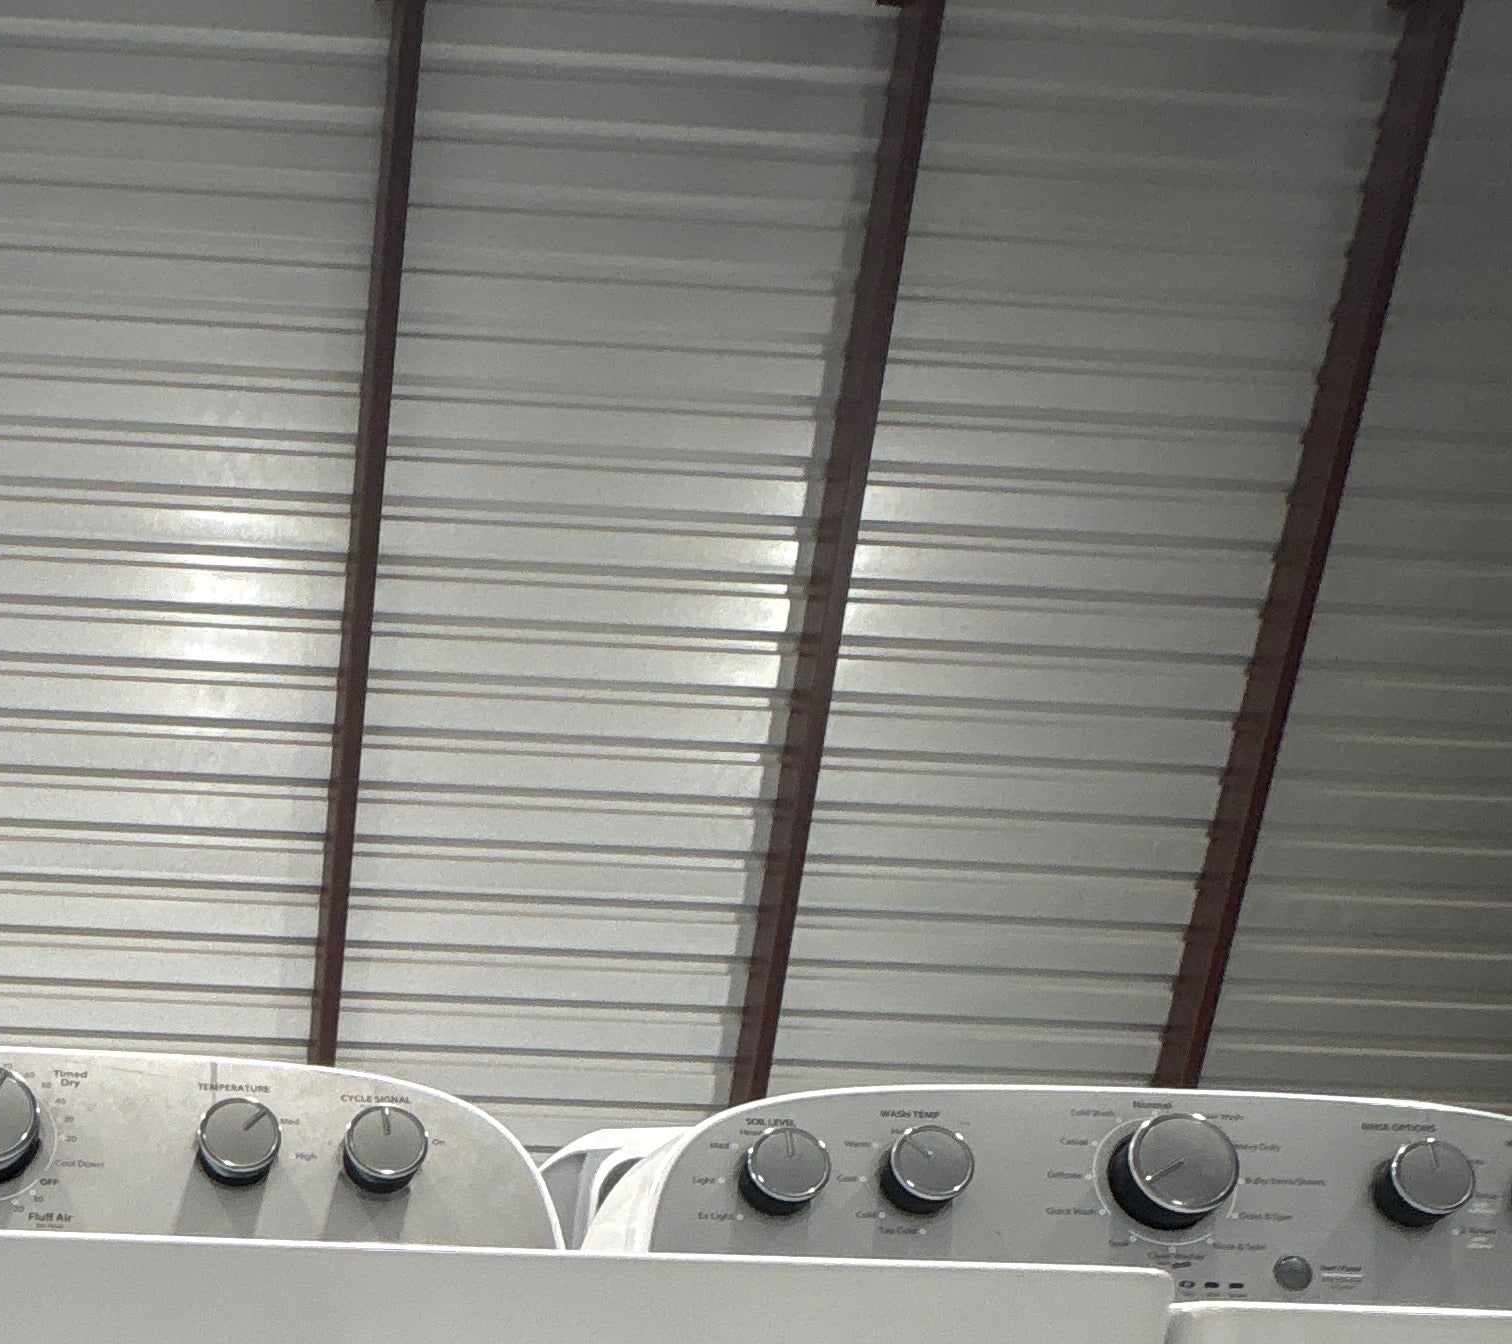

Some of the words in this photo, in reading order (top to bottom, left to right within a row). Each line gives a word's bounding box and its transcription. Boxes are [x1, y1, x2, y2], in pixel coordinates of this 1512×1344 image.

[53, 1070, 88, 1079] Timed
[60, 1079, 80, 1088] Dry
[198, 1083, 270, 1094] TEMPERATURE
[341, 1094, 372, 1103] CYCLE
[375, 1095, 410, 1104] SIGNAL
[880, 1110, 910, 1118] WASH
[912, 1111, 940, 1119] TEMP
[40, 1178, 59, 1186] OFF
[28, 1212, 52, 1222] Fluff
[56, 1213, 74, 1222] Air
